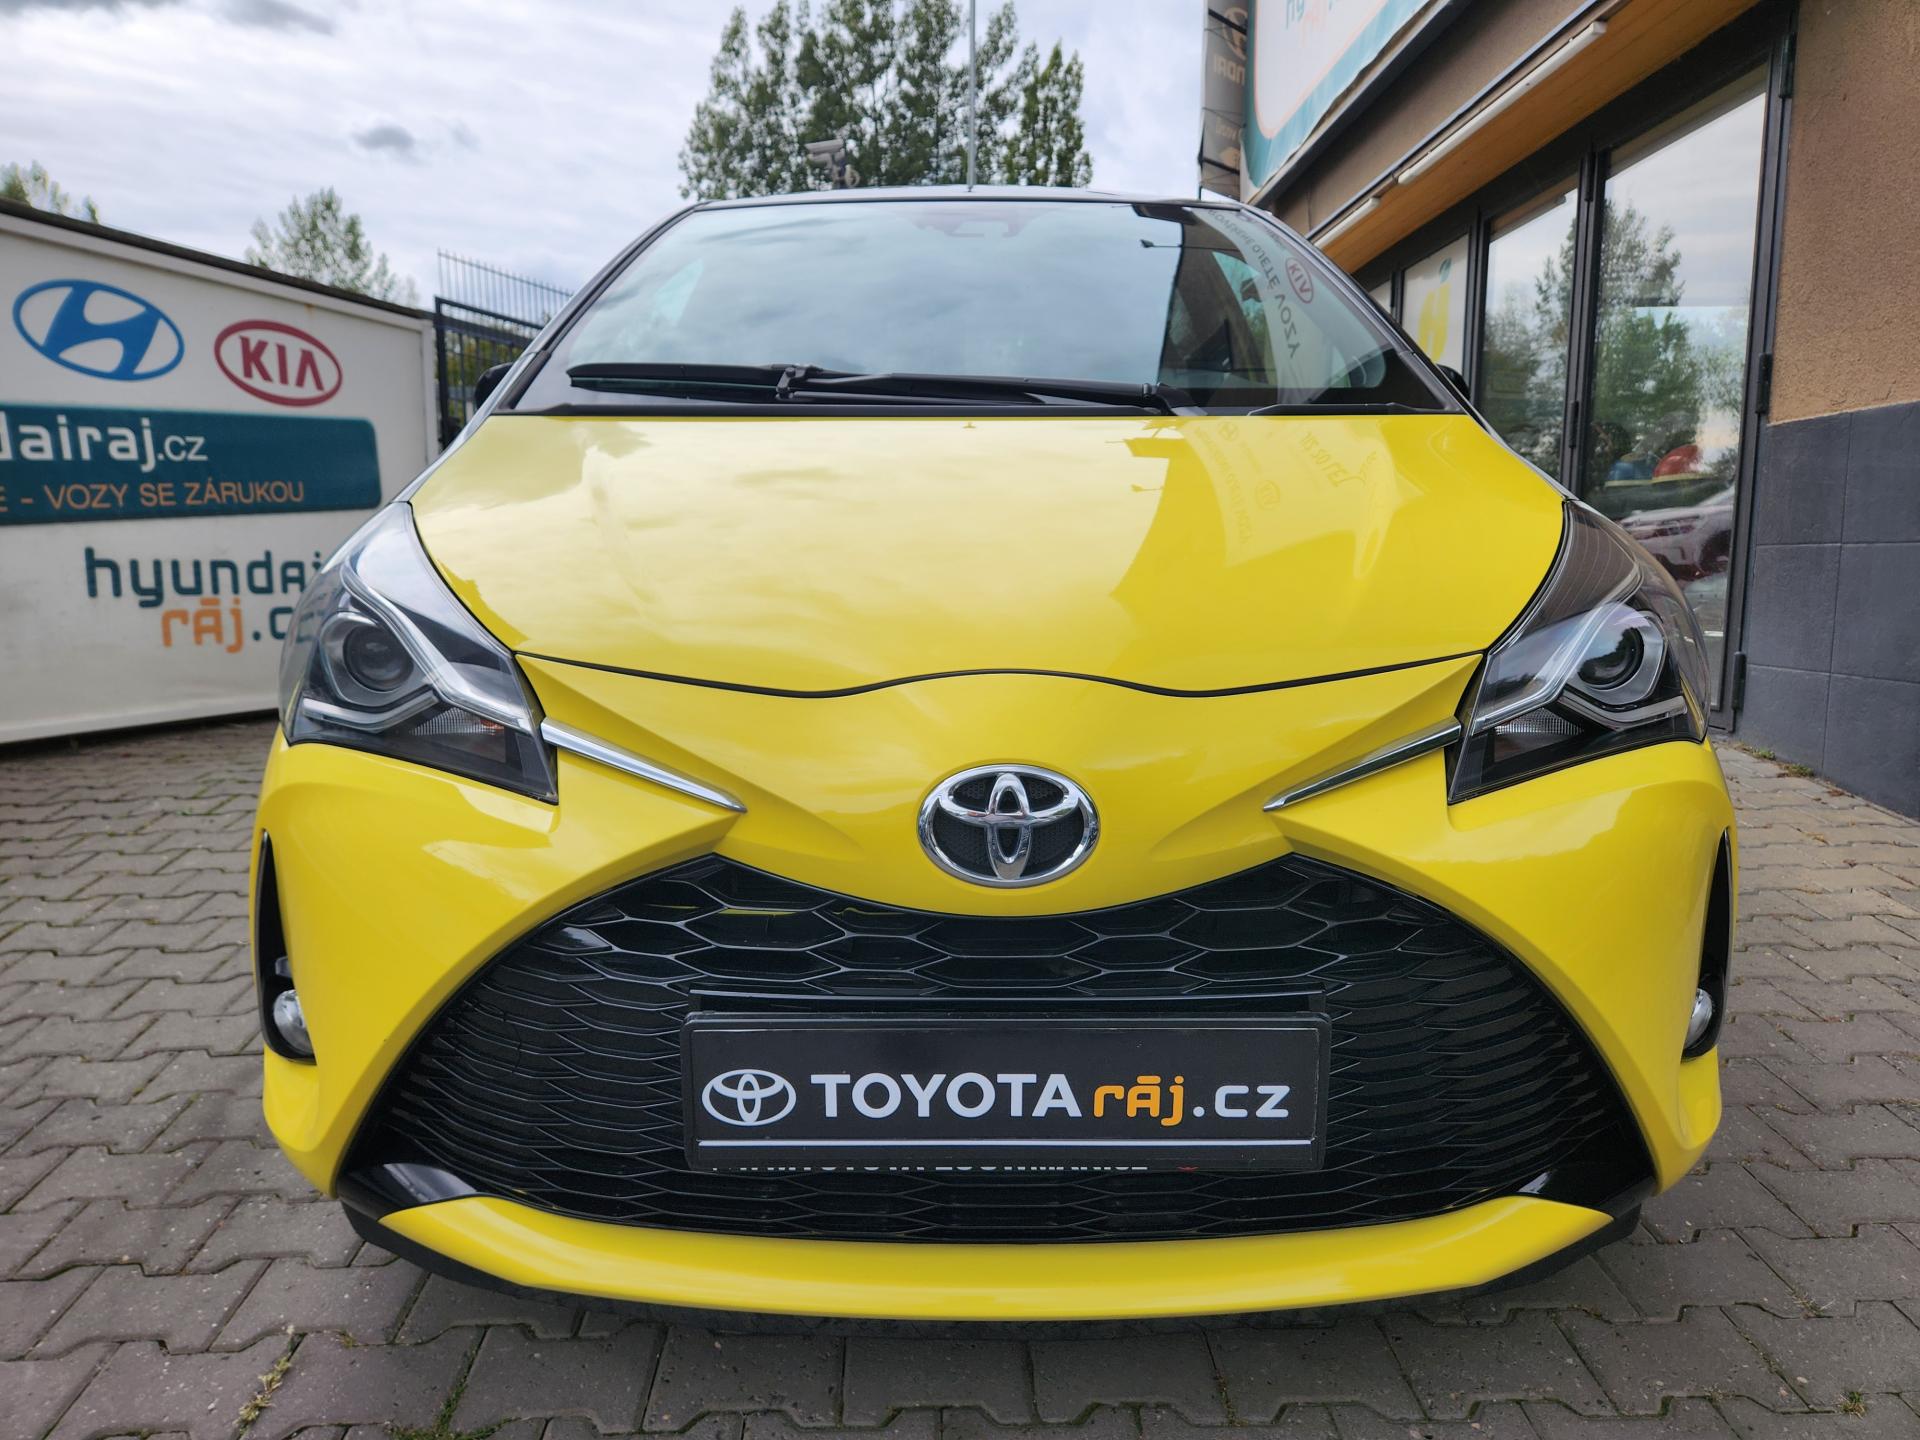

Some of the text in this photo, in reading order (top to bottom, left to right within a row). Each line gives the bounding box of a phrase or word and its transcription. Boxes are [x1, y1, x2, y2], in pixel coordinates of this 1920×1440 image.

[238, 335, 325, 392] KIA
[44, 483, 128, 510] VOZY
[139, 481, 176, 507] SE
[183, 476, 304, 506] ZÁRUKOU
[810, 1072, 1082, 1119] TOYOTA
